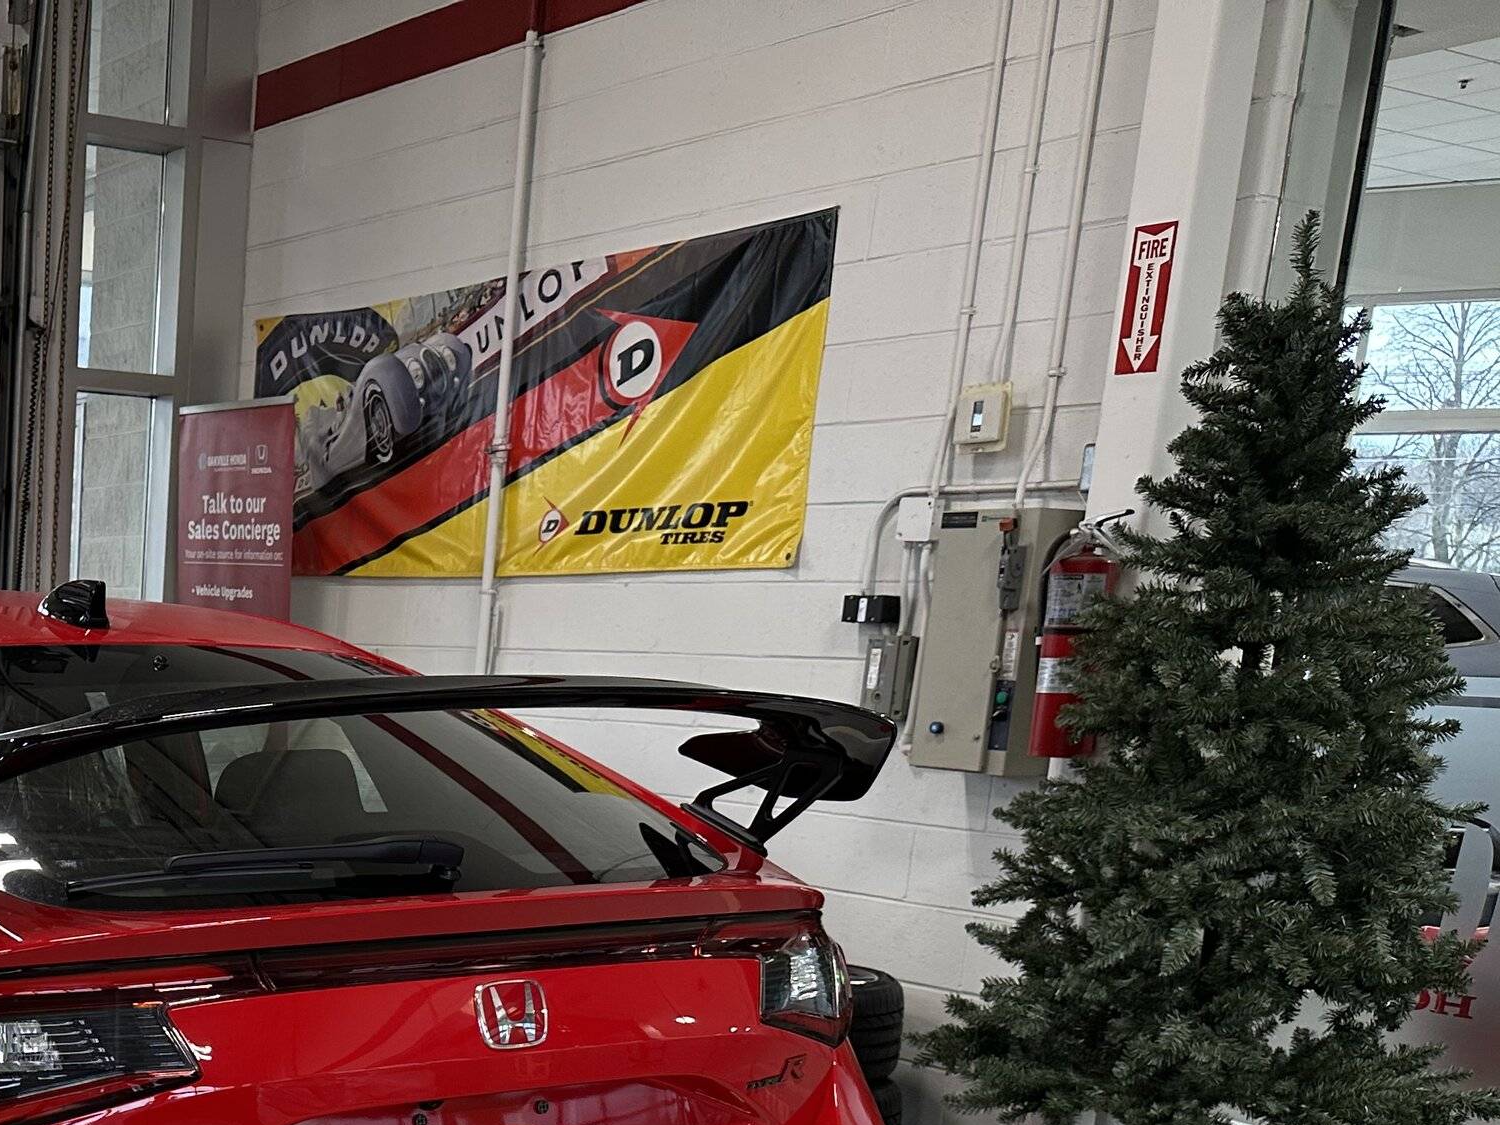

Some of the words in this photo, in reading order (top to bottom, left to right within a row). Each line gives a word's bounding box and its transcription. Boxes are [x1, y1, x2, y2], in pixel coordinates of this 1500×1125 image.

[1138, 238, 1169, 260] FIRE
[1133, 262, 1154, 361] EXTINGUISHER
[269, 320, 380, 380] DUNLOP
[617, 338, 654, 387] D
[251, 466, 272, 474] HONDA
[202, 493, 226, 514] Talk
[229, 496, 243, 514] to
[246, 497, 266, 513] our
[574, 501, 749, 536] DUNLOP
[188, 519, 219, 541] Sales
[221, 519, 280, 547] Concierge
[659, 530, 726, 546] TIRES
[234, 549, 243, 560] for
[195, 584, 221, 598] Vehicle
[221, 585, 253, 601] Upgrades
